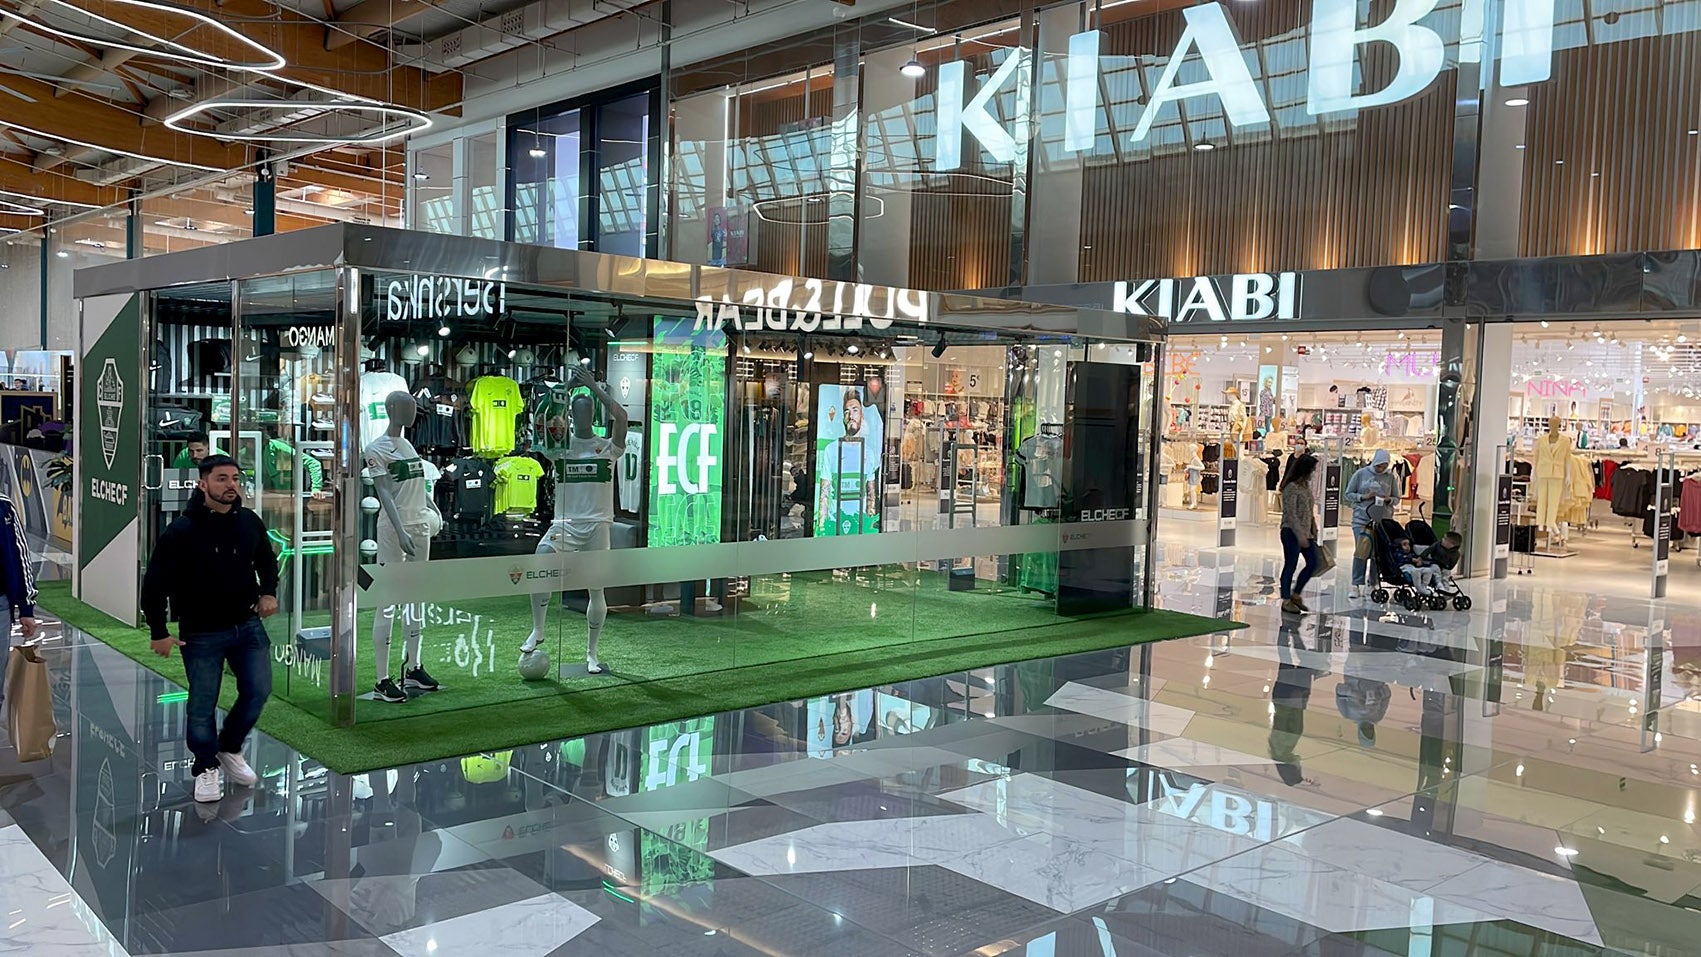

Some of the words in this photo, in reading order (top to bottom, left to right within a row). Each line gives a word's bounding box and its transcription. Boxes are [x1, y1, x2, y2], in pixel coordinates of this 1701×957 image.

[1113, 271, 1297, 322] KIABI
[656, 423, 717, 495] ECF
[91, 477, 128, 506] ELCHECF
[1081, 508, 1130, 522] ELCHECF
